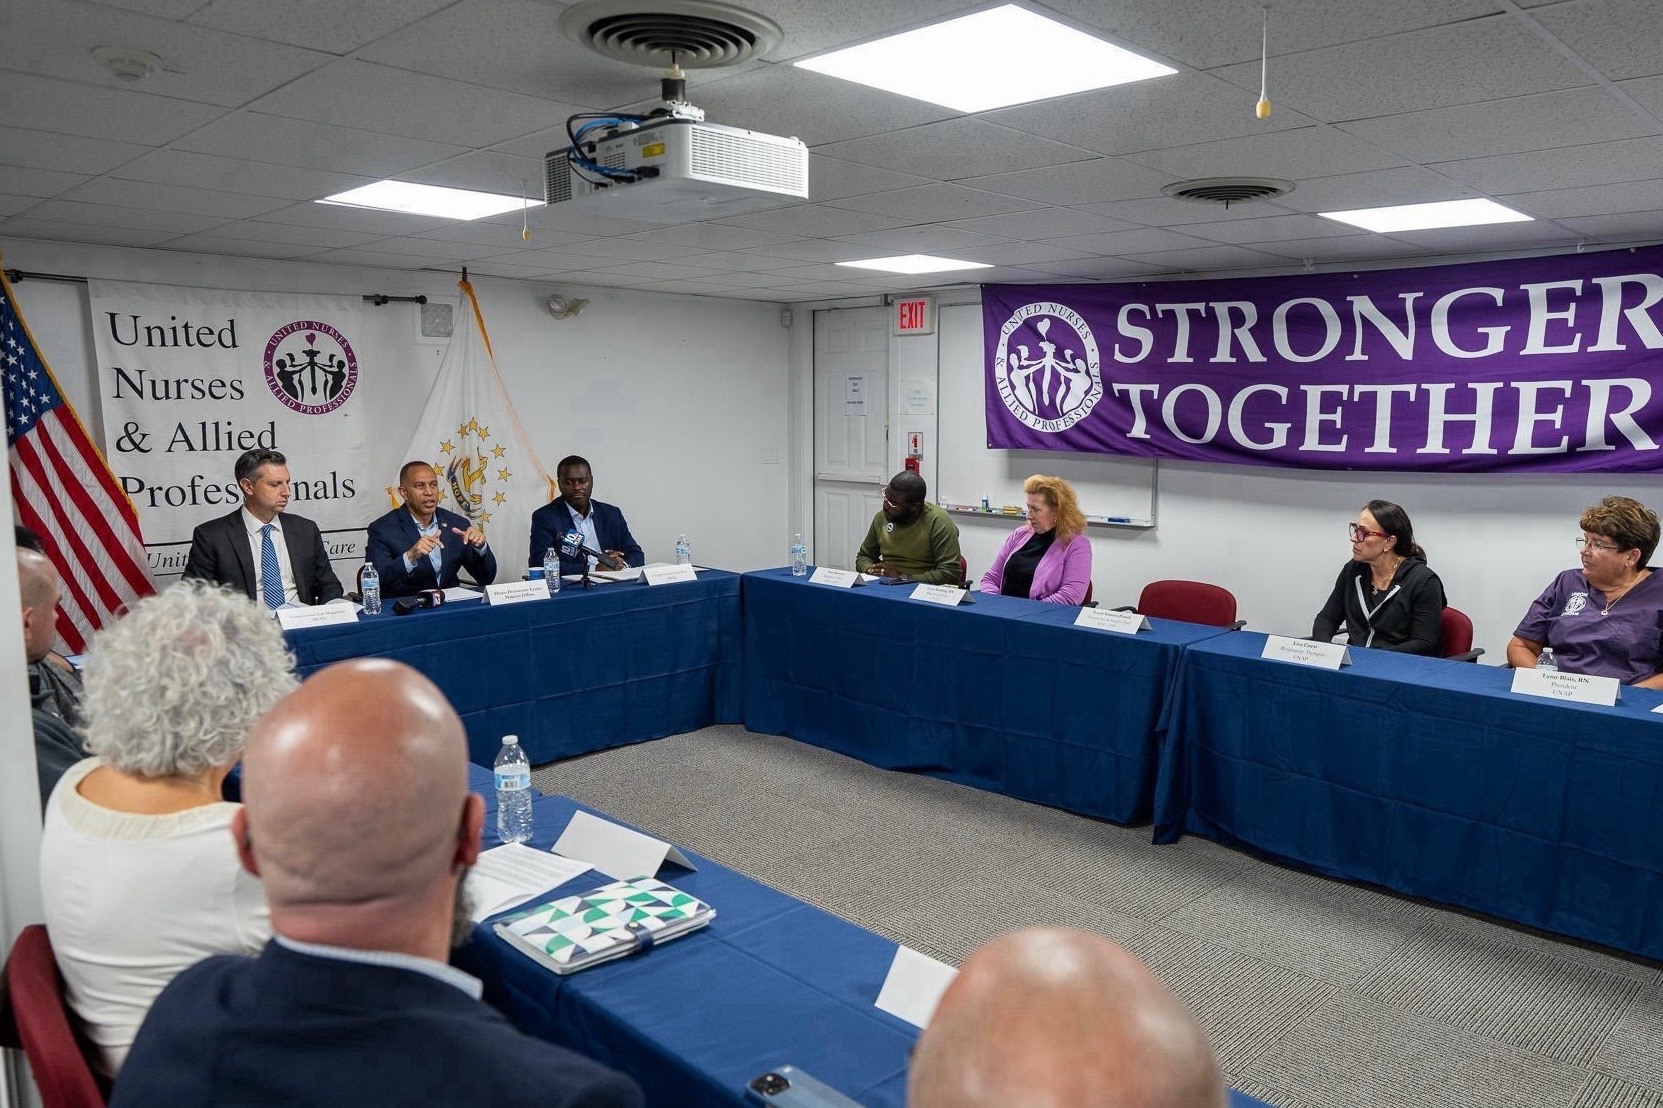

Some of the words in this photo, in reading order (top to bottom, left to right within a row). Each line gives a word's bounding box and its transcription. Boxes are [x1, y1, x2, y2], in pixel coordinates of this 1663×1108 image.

[105, 312, 240, 349] United
[900, 301, 926, 329] EXIT
[1002, 303, 1042, 336] UNITED
[1047, 303, 1091, 340] NURSES
[1113, 273, 1663, 364] STRONGER
[269, 321, 308, 347] UNITED
[311, 322, 349, 348] NURSES
[263, 360, 272, 370] &
[996, 356, 1006, 367] &
[111, 367, 245, 401] Nurses
[265, 374, 297, 408] ALLIED
[299, 361, 358, 415] PROFESSIONALS
[996, 376, 1028, 421] ALLIED
[1032, 361, 1103, 431] PROFESSIONALS
[1111, 377, 1660, 455] TOGETHER
[115, 421, 153, 454] &
[165, 420, 278, 452] Allied
[118, 470, 356, 508] Profesnals
[452, 481, 469, 509] HOPE
[1542, 673, 1560, 681] Lynn
[1551, 682, 1577, 690] President
